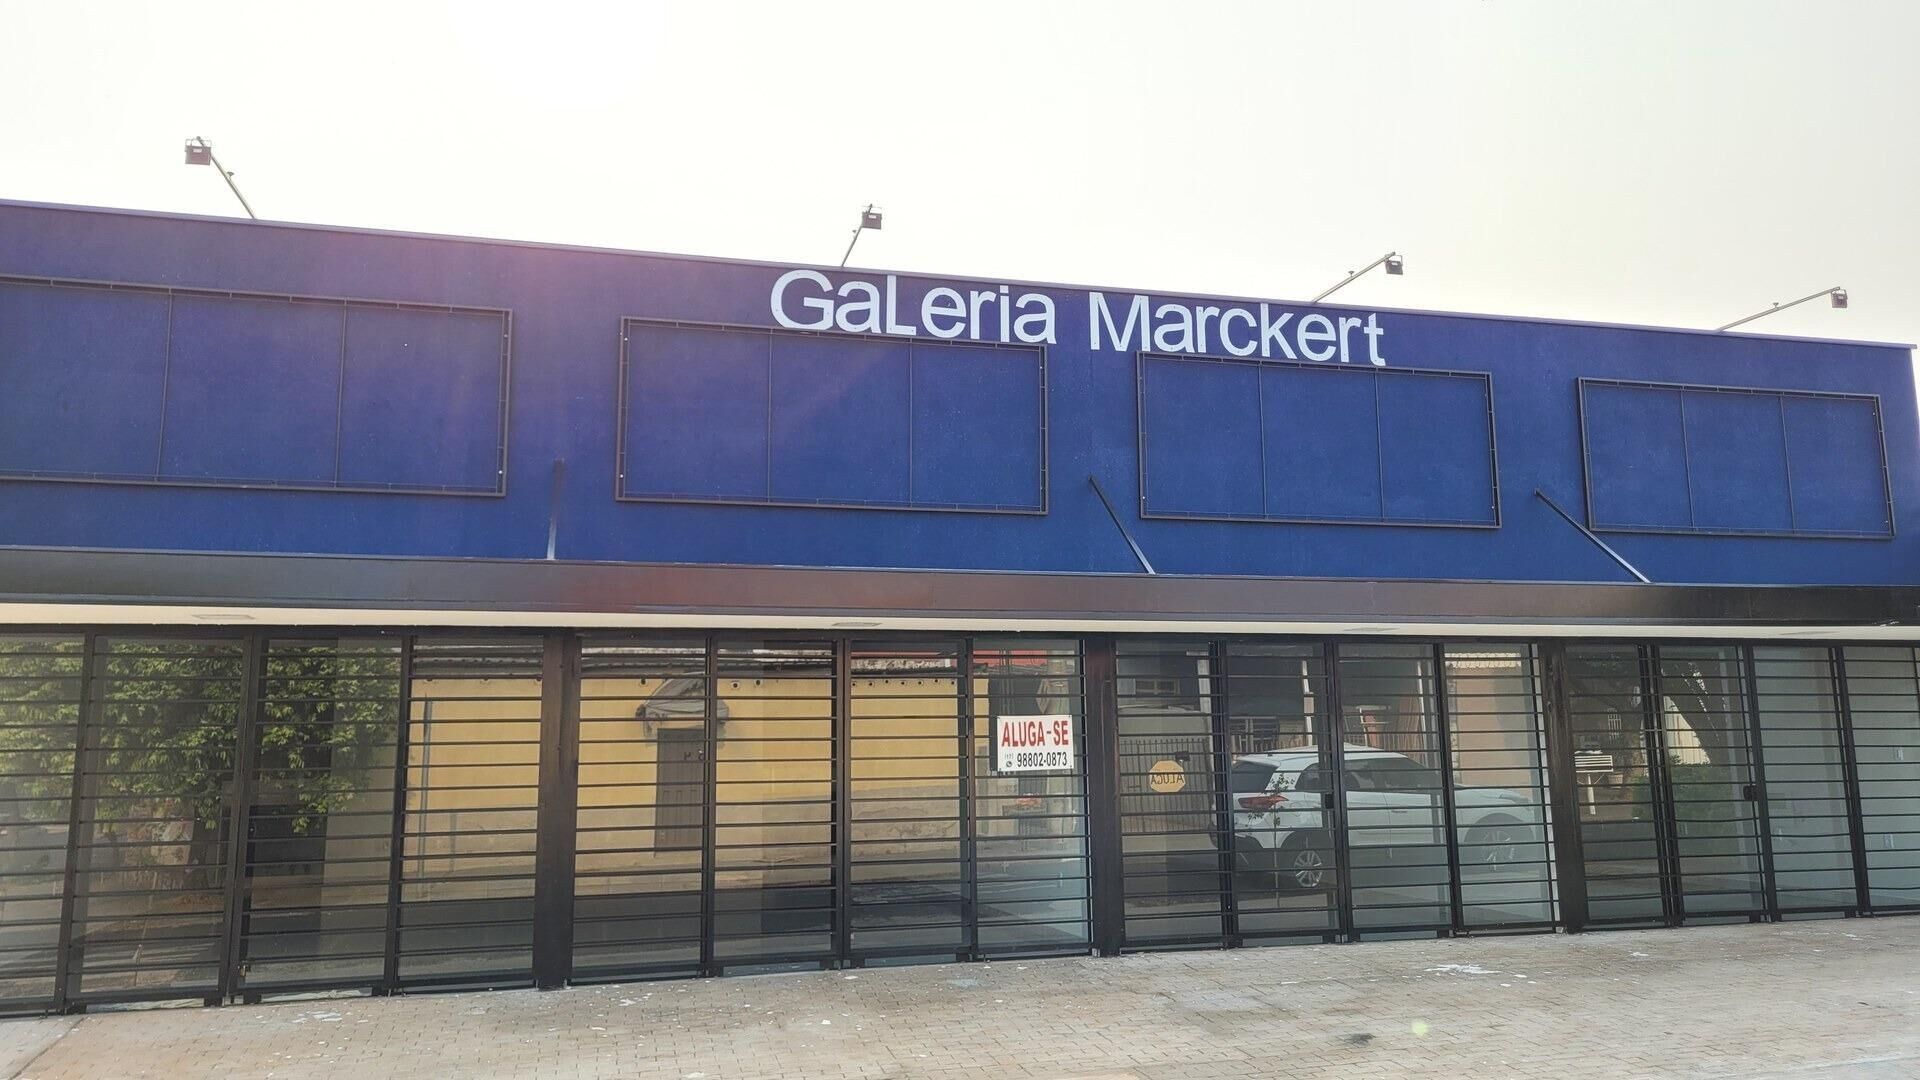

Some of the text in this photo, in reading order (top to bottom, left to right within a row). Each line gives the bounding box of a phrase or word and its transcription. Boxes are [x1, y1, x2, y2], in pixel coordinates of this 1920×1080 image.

[1088, 290, 1386, 368] Marckert
[1001, 720, 1069, 747] ALUGA-SE
[1016, 752, 1068, 767] 98802-0873
